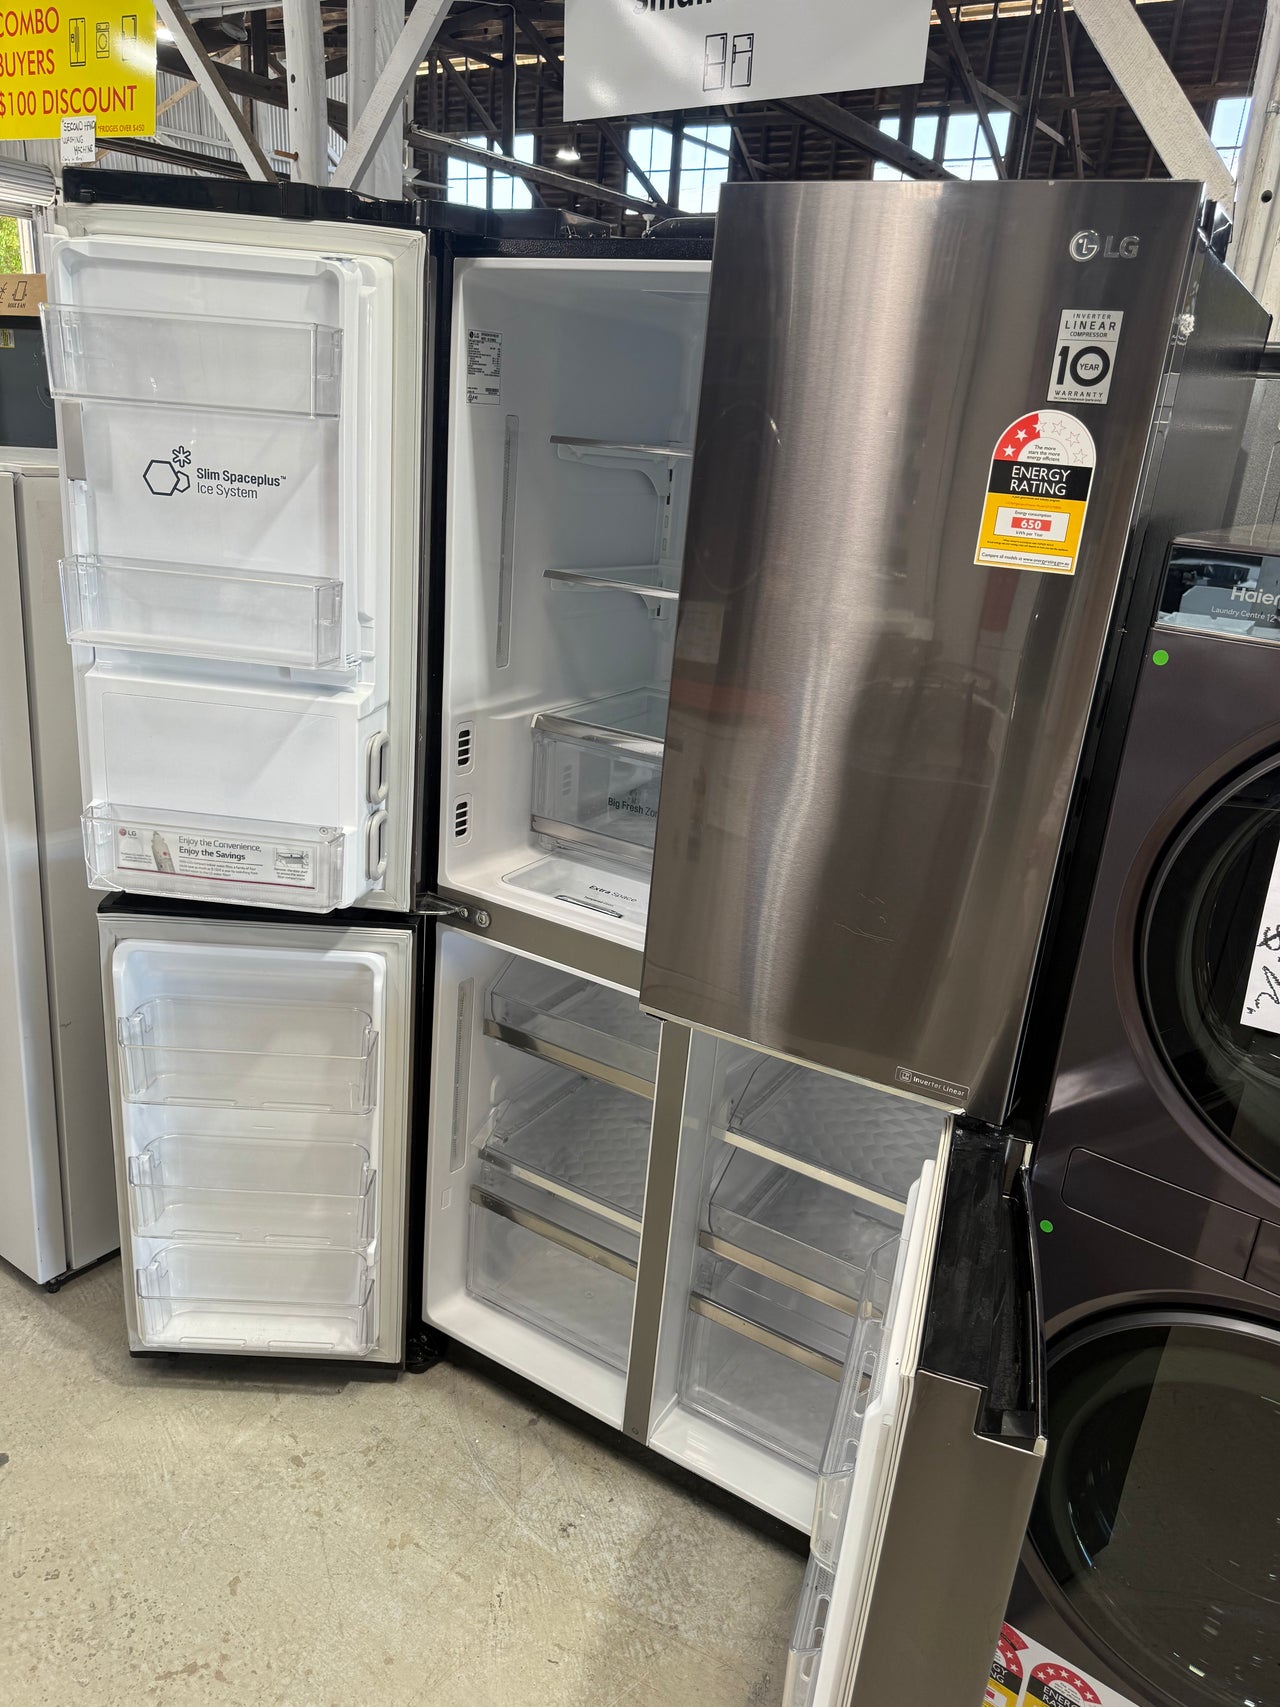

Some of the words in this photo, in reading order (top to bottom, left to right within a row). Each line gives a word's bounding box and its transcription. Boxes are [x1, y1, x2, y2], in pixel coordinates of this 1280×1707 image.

[43, 85, 137, 115] DISCOUNT
[133, 124, 145, 132] $450
[1104, 234, 1140, 260] LG
[1064, 320, 1117, 332] LINEAR
[1056, 345, 1111, 387] 10
[1079, 363, 1100, 371] YEAR
[1054, 390, 1104, 398] WARRANTY
[196, 467, 220, 481] Slim
[1011, 465, 1071, 482] ENERGY
[197, 482, 214, 495] Ice
[216, 483, 258, 499] System
[1010, 479, 1068, 496] RATING
[1020, 519, 1042, 530] 650
[1211, 605, 1240, 617] Laundry
[1240, 610, 1266, 620] Centre
[608, 797, 620, 810] Big
[622, 800, 644, 815] Fresh
[127, 830, 137, 838] LG
[178, 835, 199, 847] Enjoy
[199, 838, 213, 847] the
[213, 839, 262, 853] Convenience,
[179, 846, 200, 857] Enjoy
[201, 848, 214, 857] the
[215, 849, 246, 861] Savings
[589, 885, 611, 895] Extra
[611, 892, 638, 902] Space
[913, 1076, 941, 1090] Inverter
[942, 1084, 965, 1097] Linear
